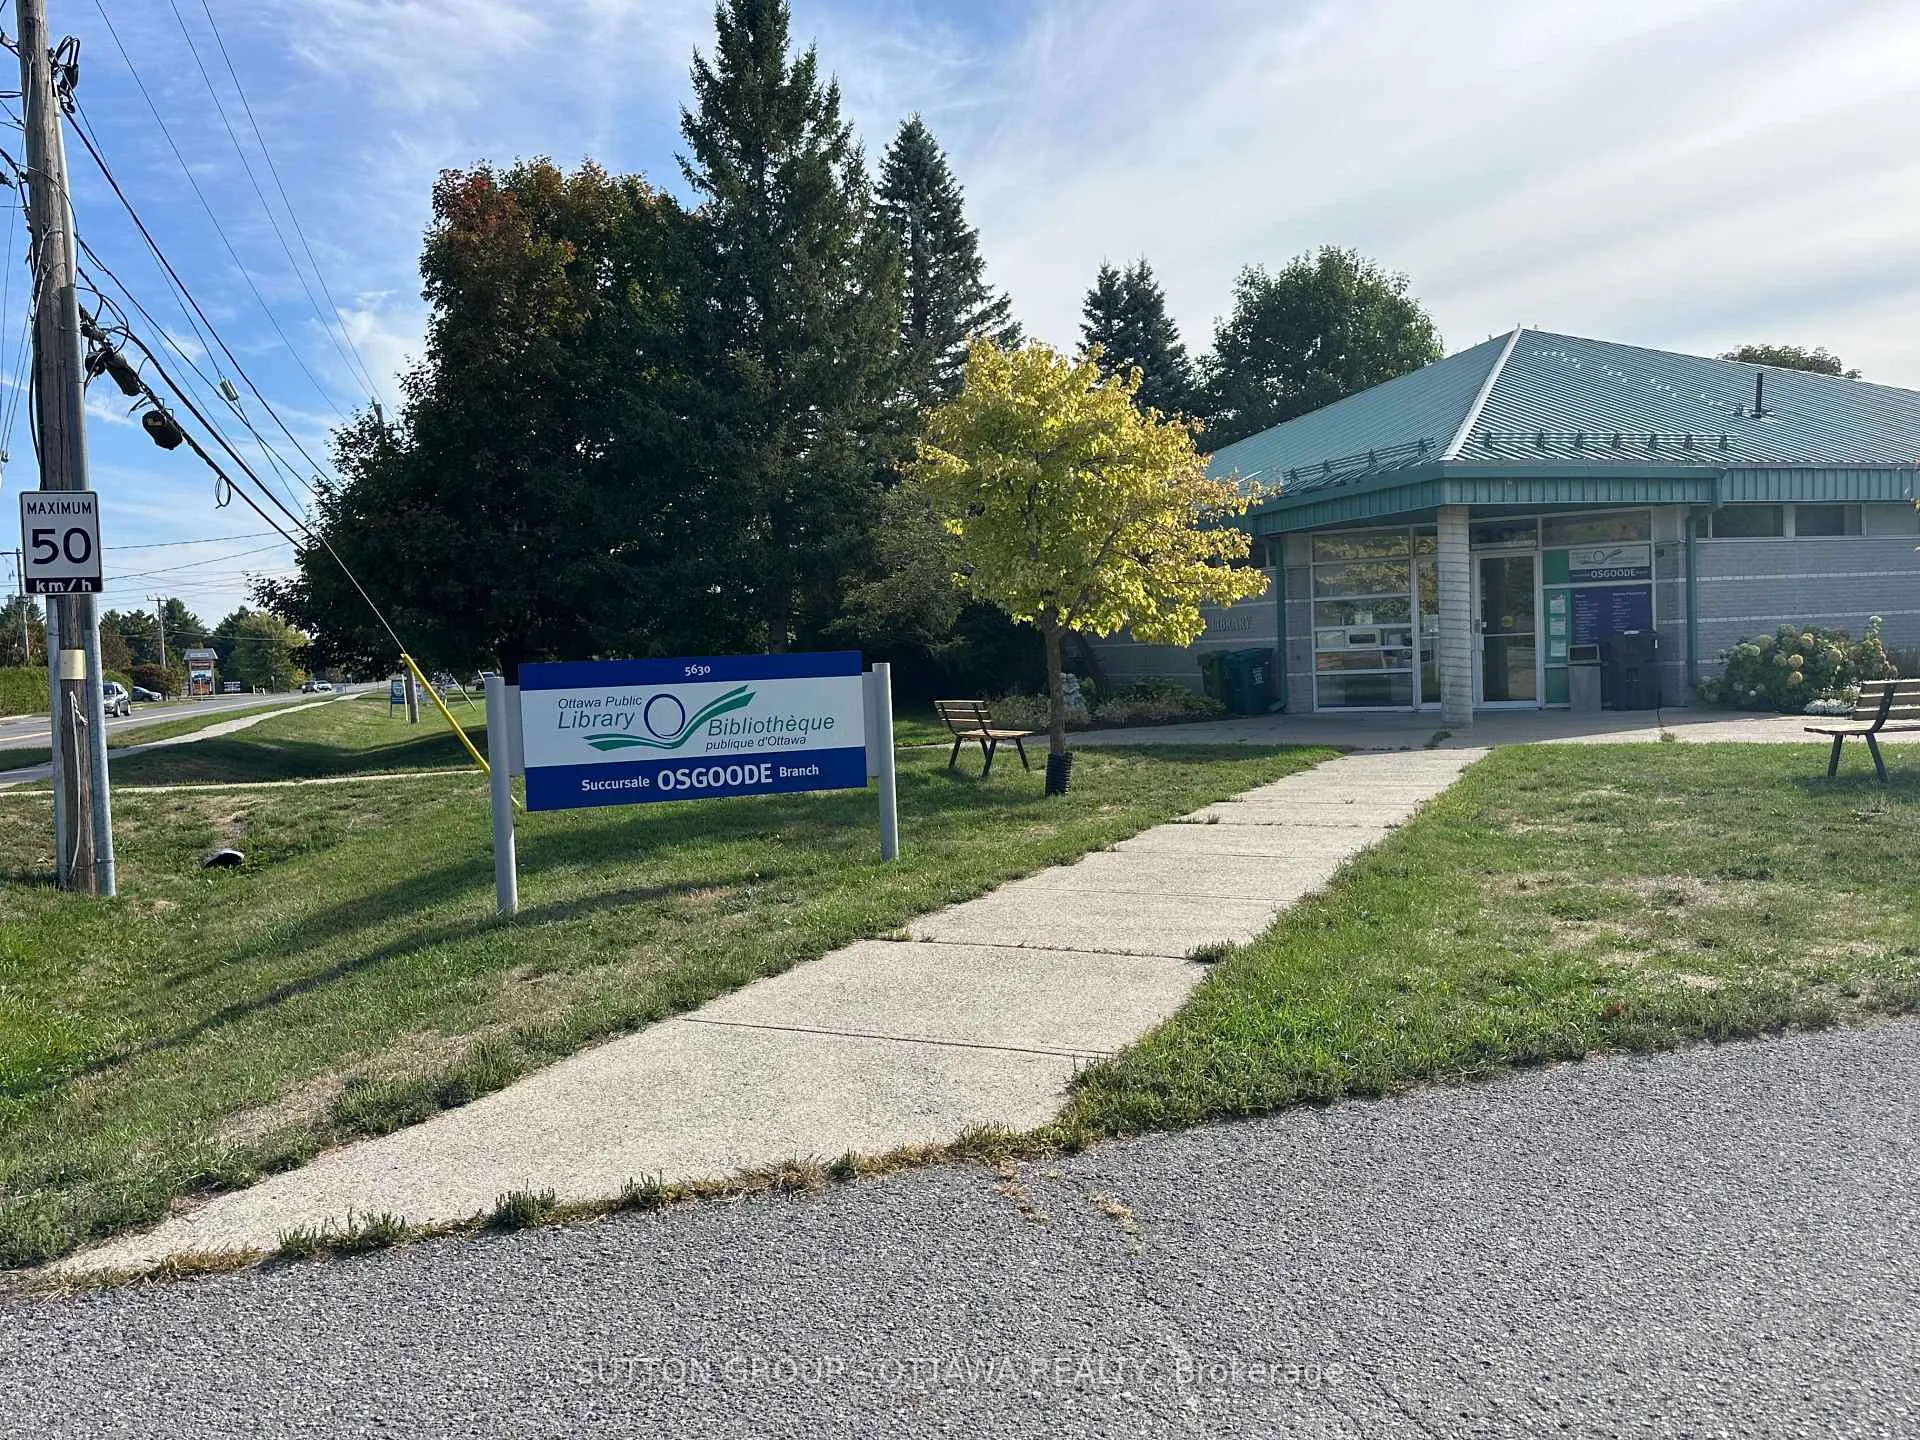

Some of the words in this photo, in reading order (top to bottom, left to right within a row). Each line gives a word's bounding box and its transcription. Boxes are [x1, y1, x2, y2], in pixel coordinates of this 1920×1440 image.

[27, 502, 91, 514] MAXIMUM
[32, 528, 91, 564] 50
[1591, 568, 1636, 578] OSGOODE
[35, 579, 92, 593] km/h
[685, 664, 711, 677] 5630
[558, 698, 601, 709] Ottawa
[605, 695, 642, 707] Public
[558, 710, 636, 730] Library
[708, 715, 835, 736] Bibliothèque
[705, 738, 754, 752] publique
[757, 735, 807, 747] d'Ottawa
[581, 776, 650, 791] Succursale
[657, 763, 773, 791] OSGOODE
[779, 764, 819, 778] Branch
